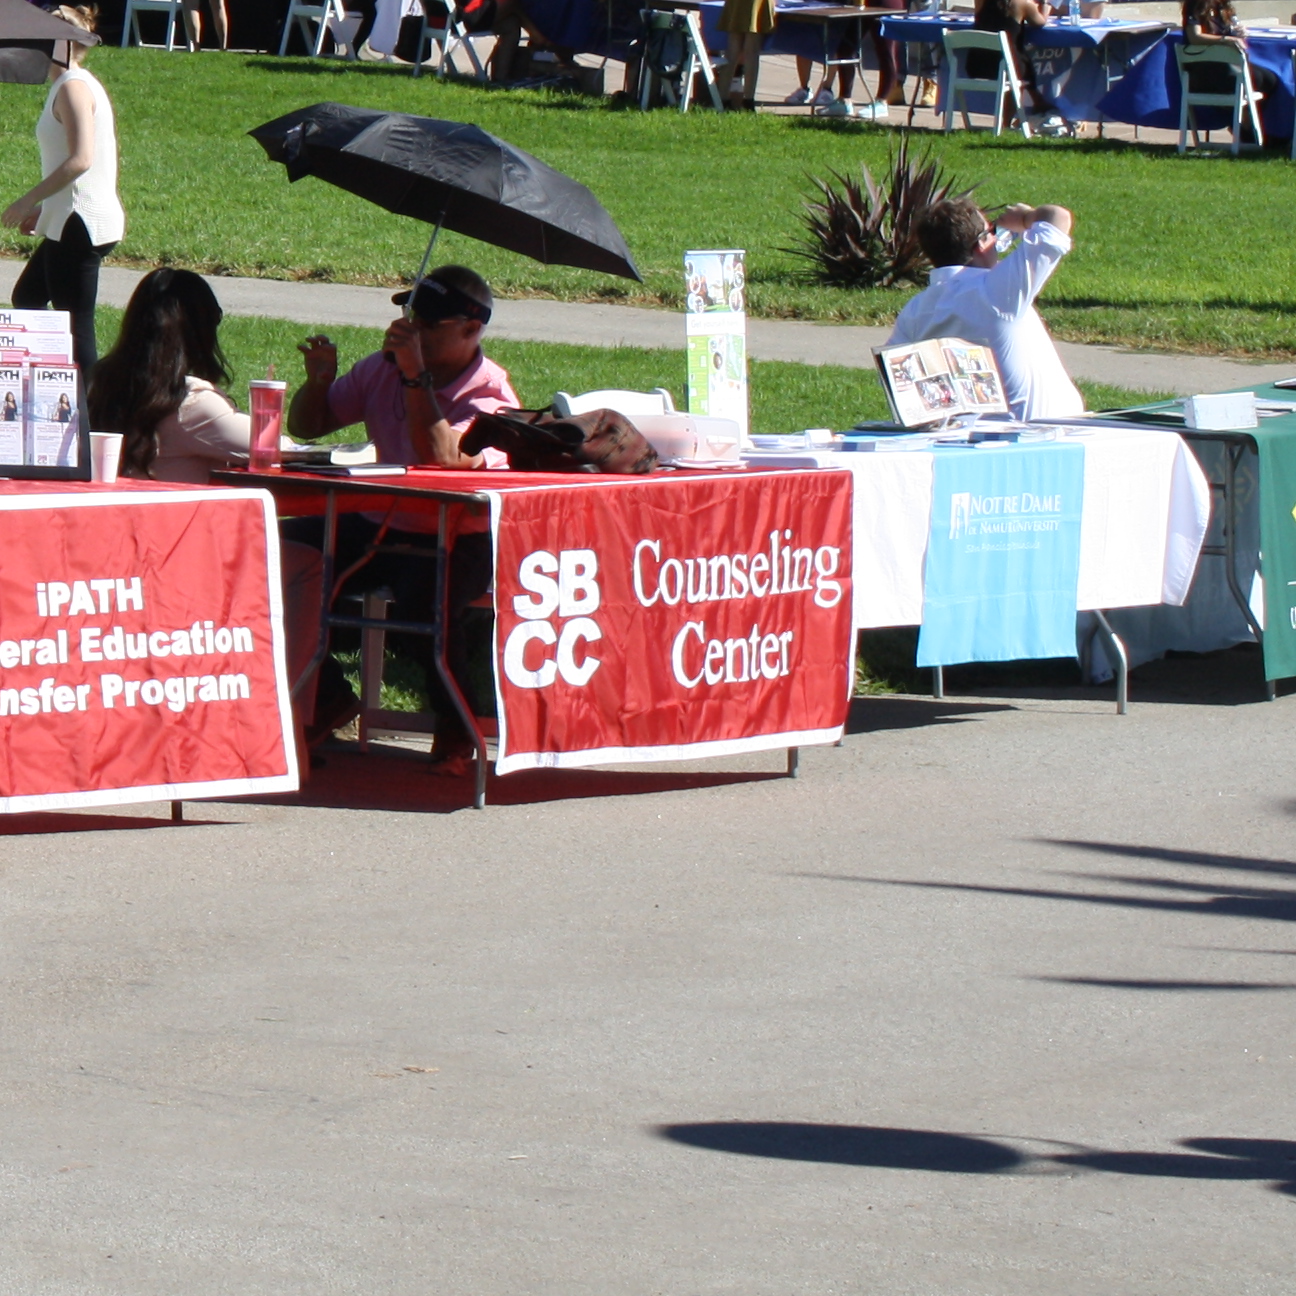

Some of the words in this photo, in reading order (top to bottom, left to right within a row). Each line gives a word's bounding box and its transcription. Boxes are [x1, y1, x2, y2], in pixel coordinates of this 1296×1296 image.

[970, 494, 1018, 516] NOTRE
[1020, 492, 1061, 514] DAME
[513, 548, 600, 619] SB
[632, 528, 842, 609] Counseling
[36, 576, 144, 618] iPATH
[79, 620, 254, 663] Education
[504, 616, 604, 689] CC
[671, 620, 794, 689] Center
[100, 672, 251, 713] Program
